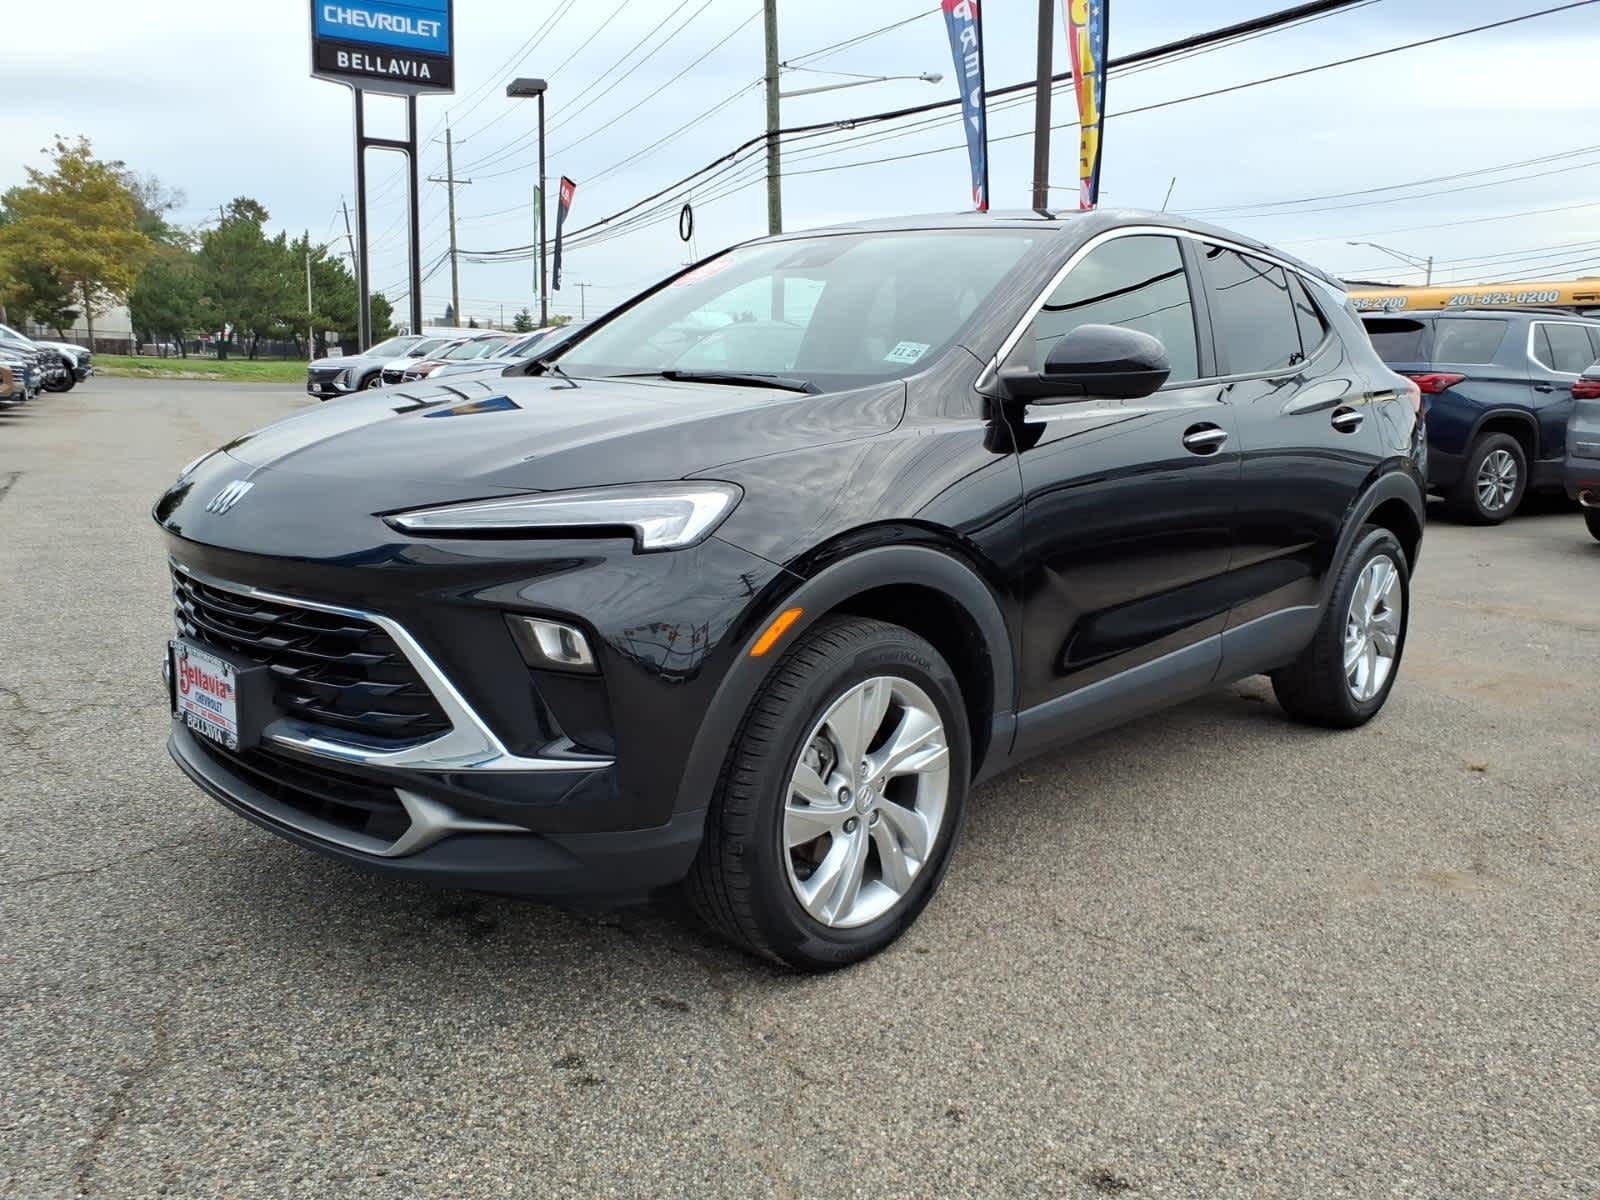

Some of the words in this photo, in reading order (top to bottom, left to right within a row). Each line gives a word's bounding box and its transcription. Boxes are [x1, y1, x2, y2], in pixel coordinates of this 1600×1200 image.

[323, 5, 441, 38] CHEVROLET
[336, 51, 431, 79] BELLAVIA
[1448, 290, 1560, 306] 201-823-0200
[186, 713, 224, 745] BELLAVIA
